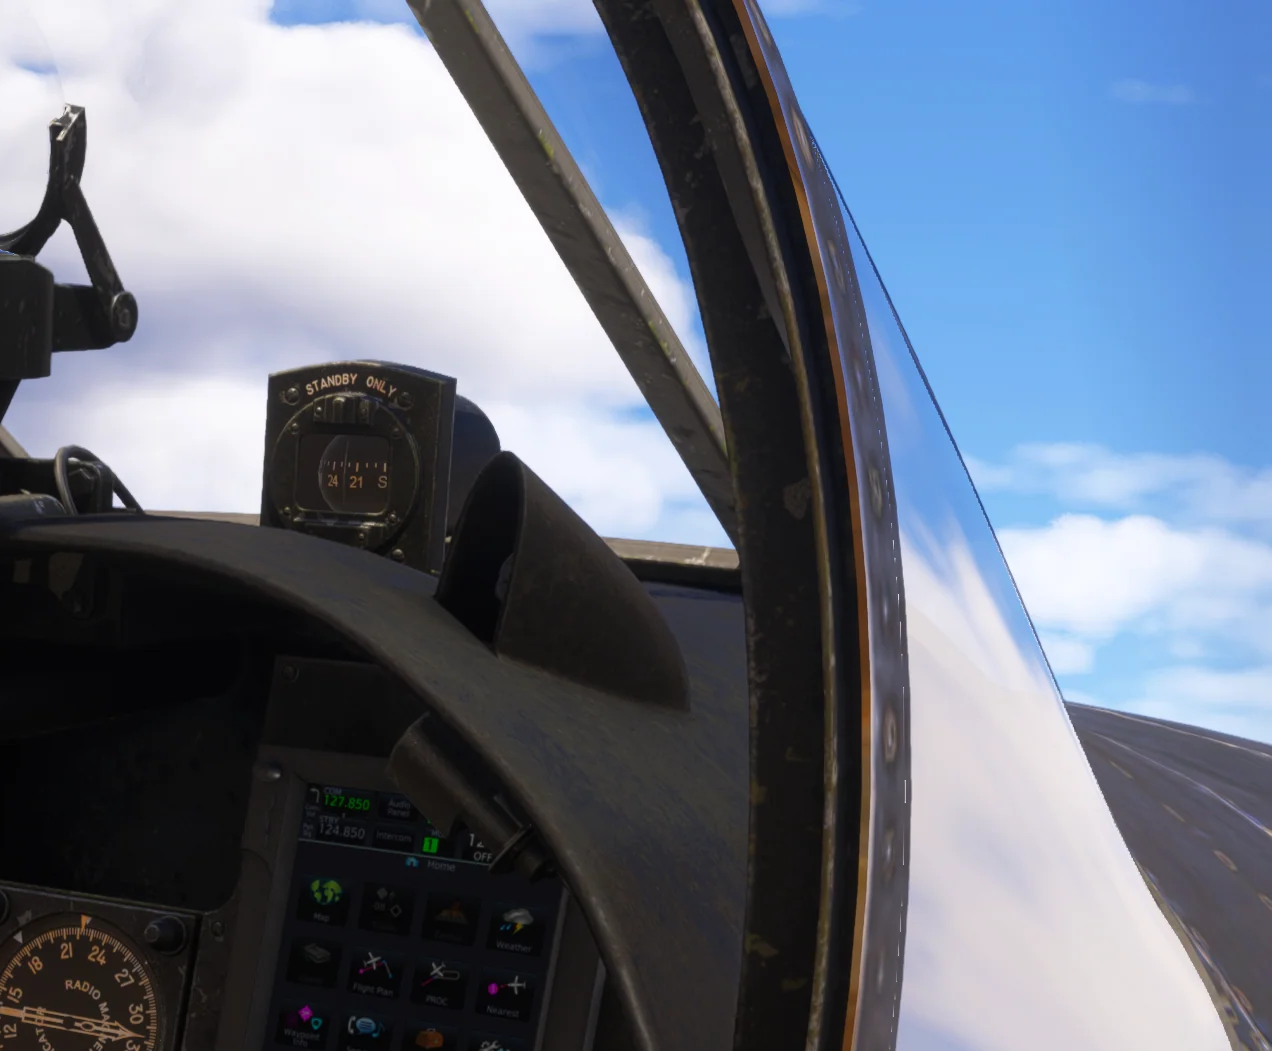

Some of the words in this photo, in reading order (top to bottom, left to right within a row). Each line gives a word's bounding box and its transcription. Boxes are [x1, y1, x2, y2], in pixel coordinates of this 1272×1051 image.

[306, 373, 357, 395] STANDBY
[366, 376, 397, 398] ONLY
[327, 475, 338, 487] 24
[349, 476, 363, 488] 21
[323, 794, 371, 811] 127.850
[319, 823, 366, 840] 124.850
[376, 830, 412, 843] Intercom
[427, 859, 456, 872] Home
[496, 939, 532, 954] Weather
[487, 1004, 520, 1018] Nearest
